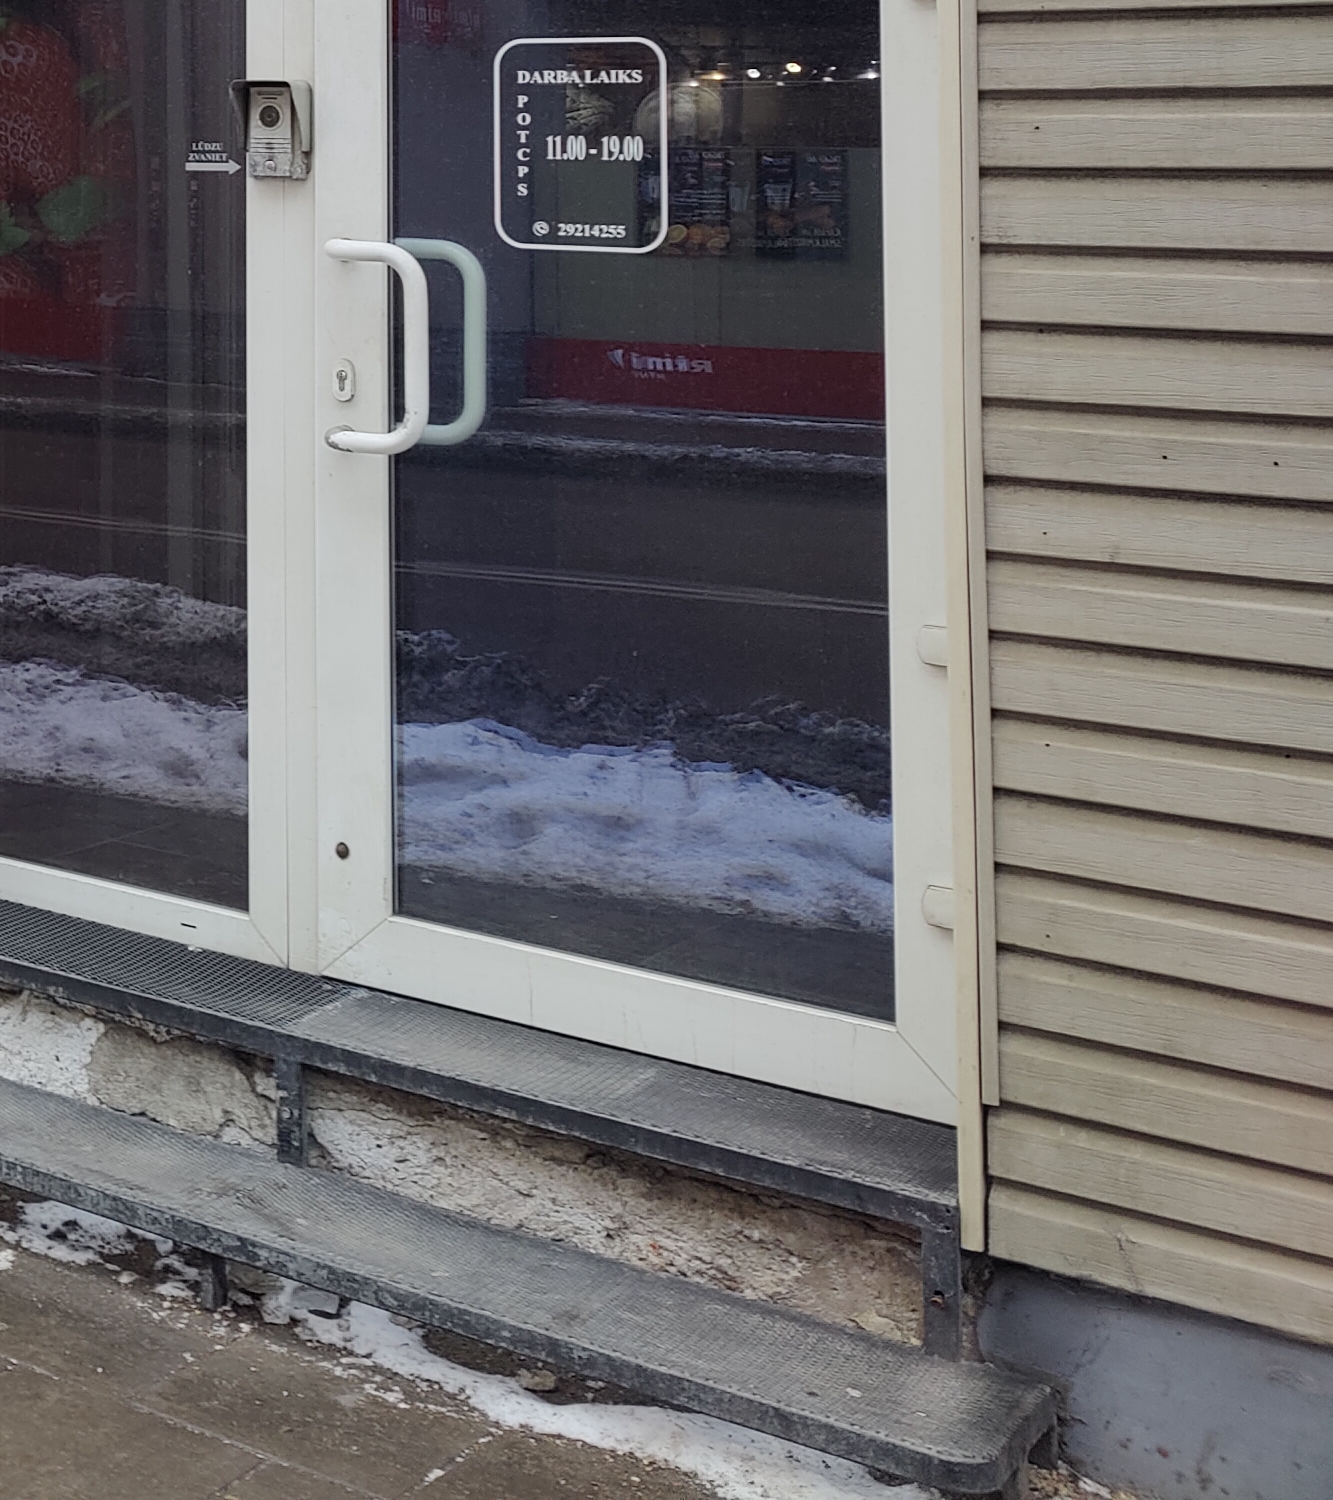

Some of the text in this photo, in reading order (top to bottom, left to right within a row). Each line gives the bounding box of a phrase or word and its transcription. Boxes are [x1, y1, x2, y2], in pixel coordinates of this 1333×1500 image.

[517, 70, 643, 84] DARBA LAIKS
[546, 135, 586, 161] 11.00
[601, 135, 644, 162] 19.00
[557, 223, 626, 239] 29214255
